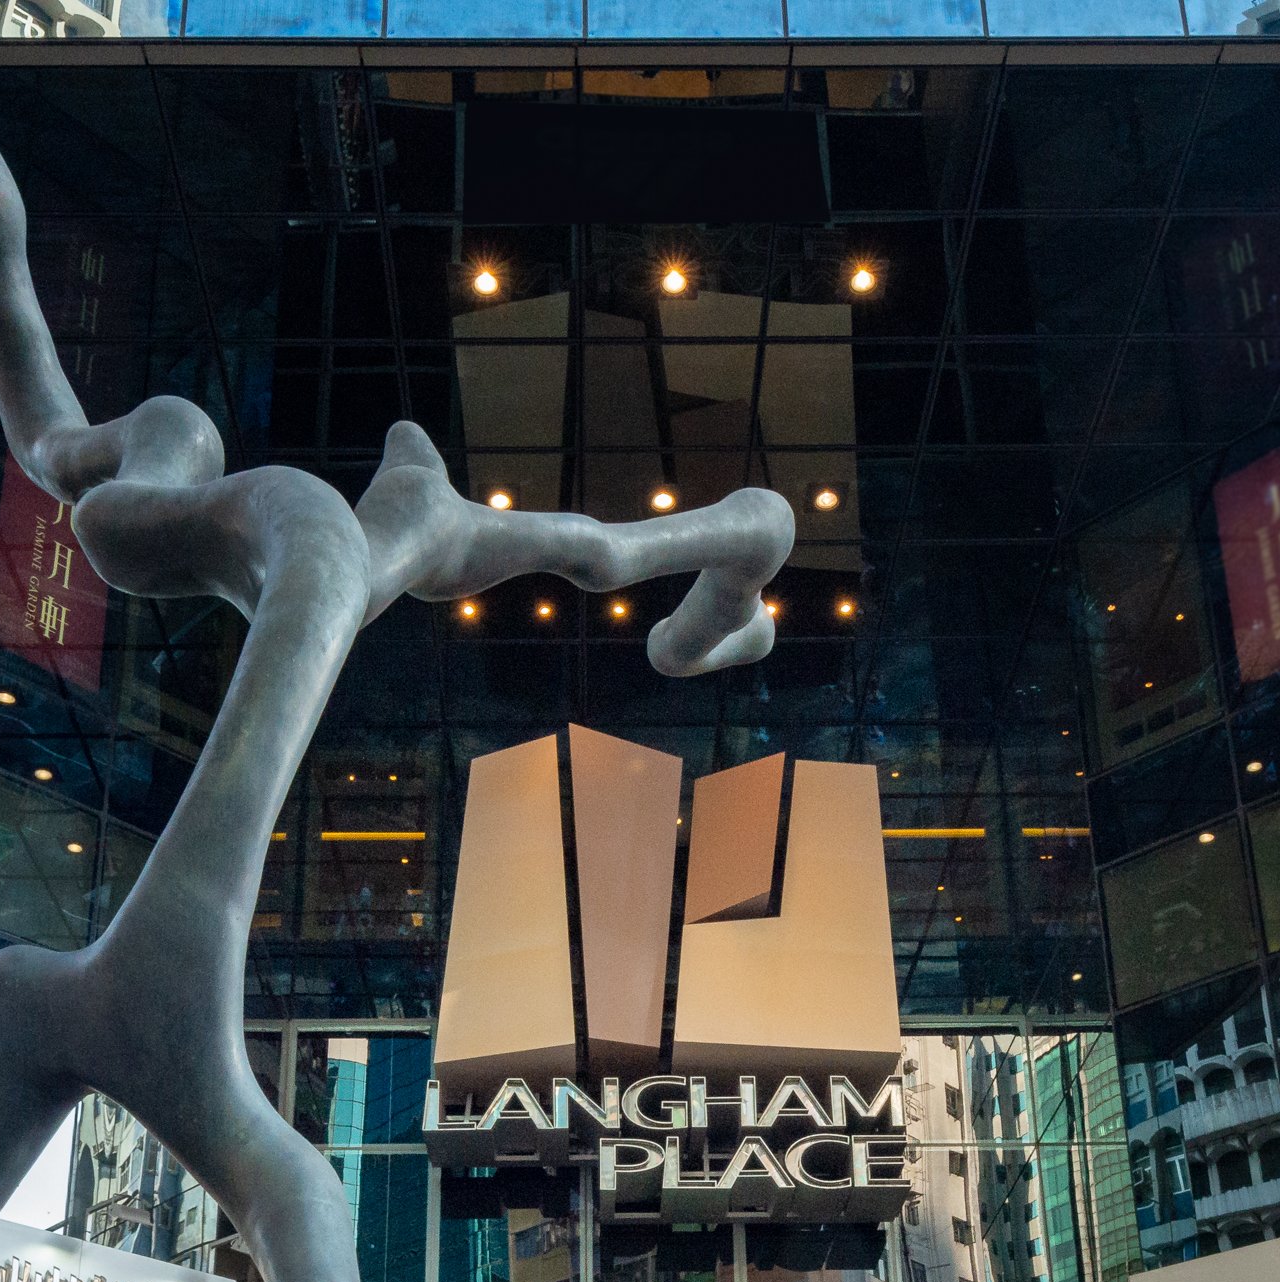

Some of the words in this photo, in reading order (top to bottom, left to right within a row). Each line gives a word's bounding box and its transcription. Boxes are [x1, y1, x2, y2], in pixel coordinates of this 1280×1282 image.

[30, 515, 47, 571] JASMINE
[24, 574, 41, 631] GARDEN
[422, 1075, 906, 1132] LANGHAM
[599, 1133, 912, 1191] PLACE
